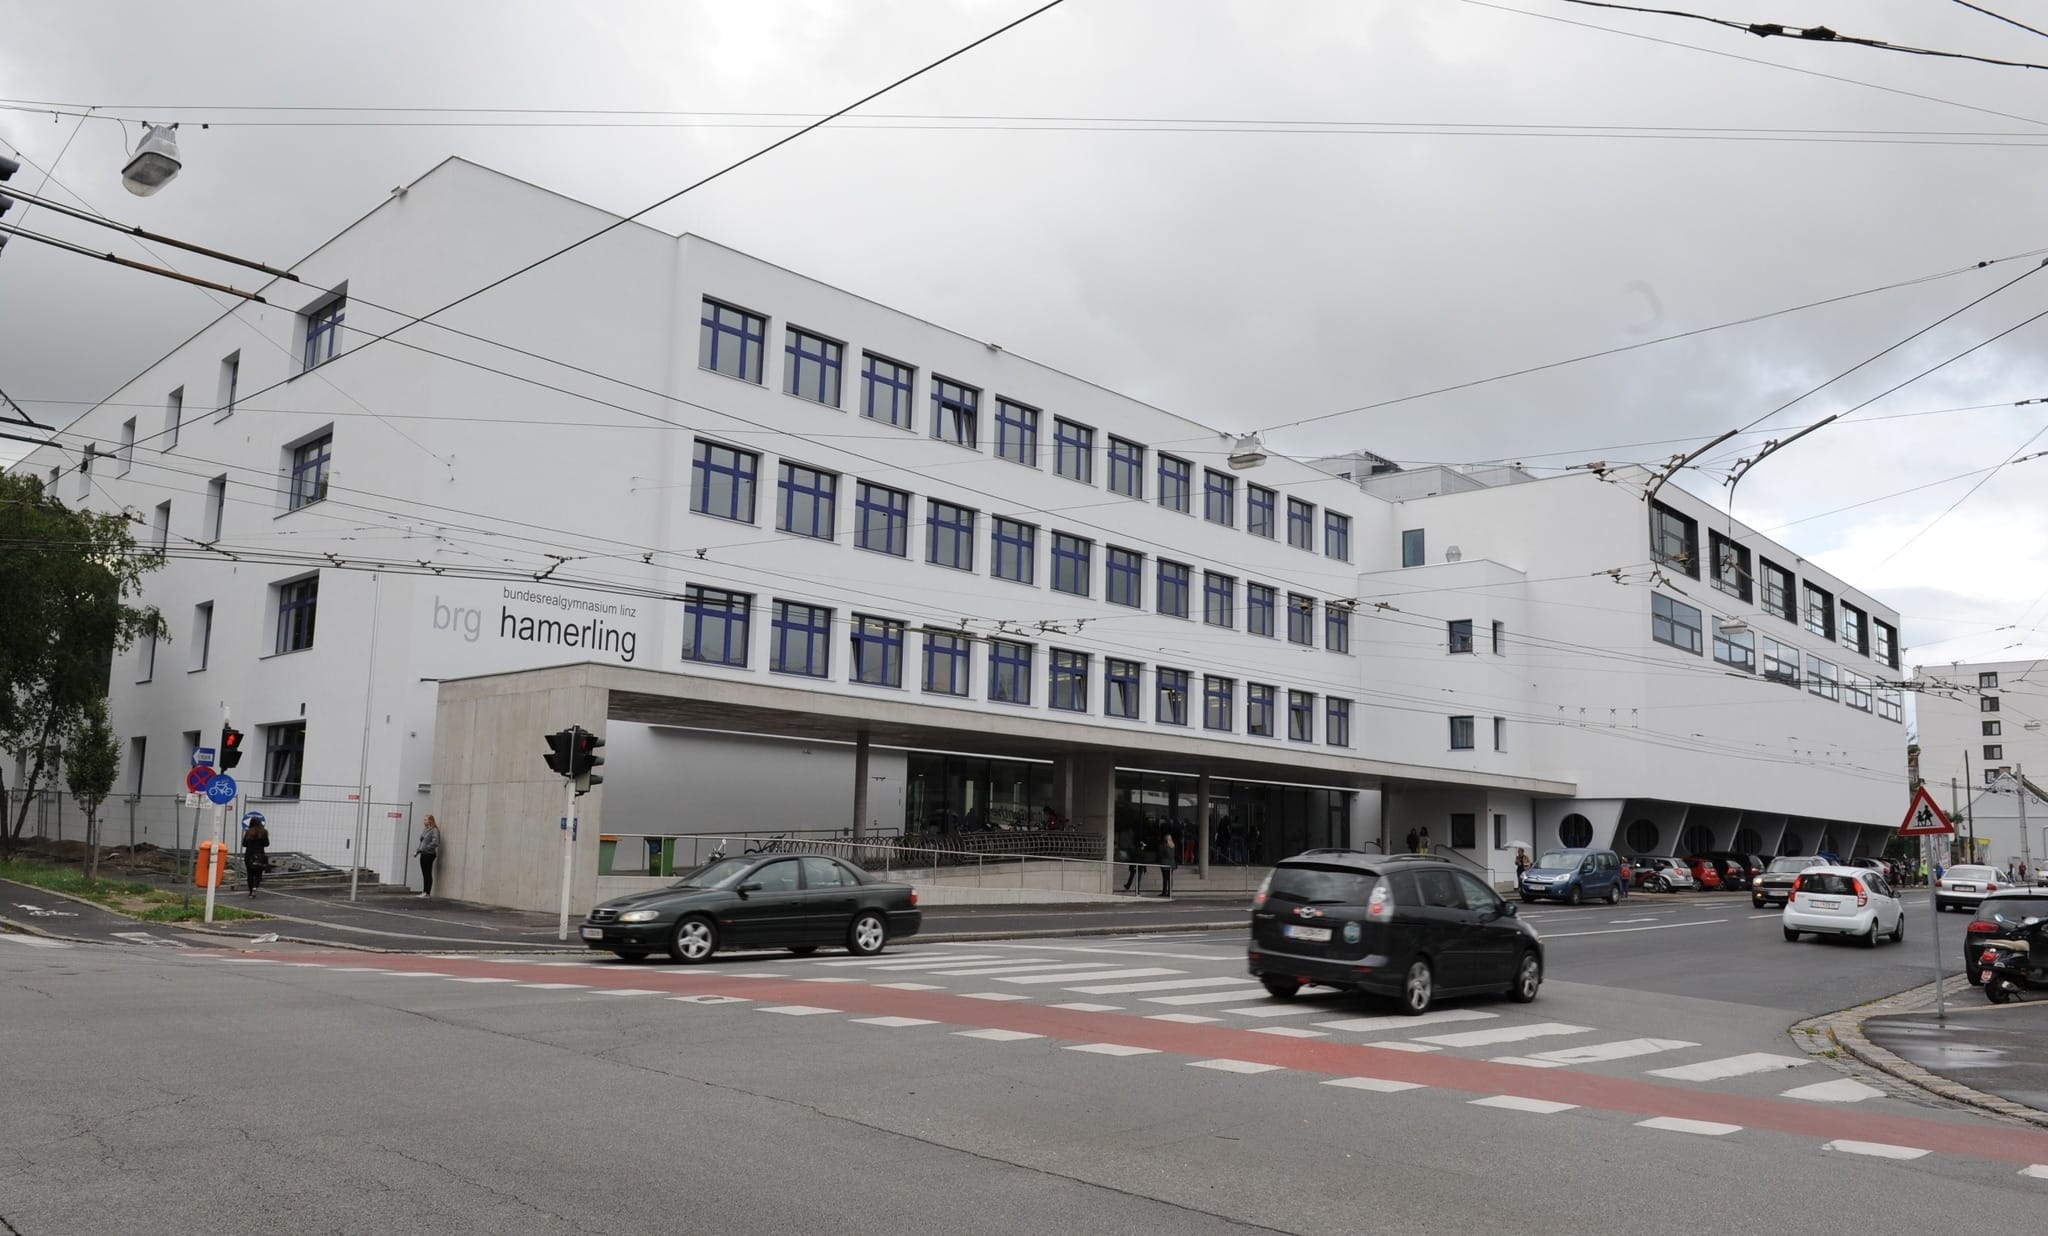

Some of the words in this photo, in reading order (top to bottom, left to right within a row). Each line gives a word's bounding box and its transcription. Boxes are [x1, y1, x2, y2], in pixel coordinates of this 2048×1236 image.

[503, 585, 617, 615] bundesrealgymnasium
[620, 603, 637, 618] linz
[433, 595, 481, 642] brg
[500, 605, 636, 662] hamerling
